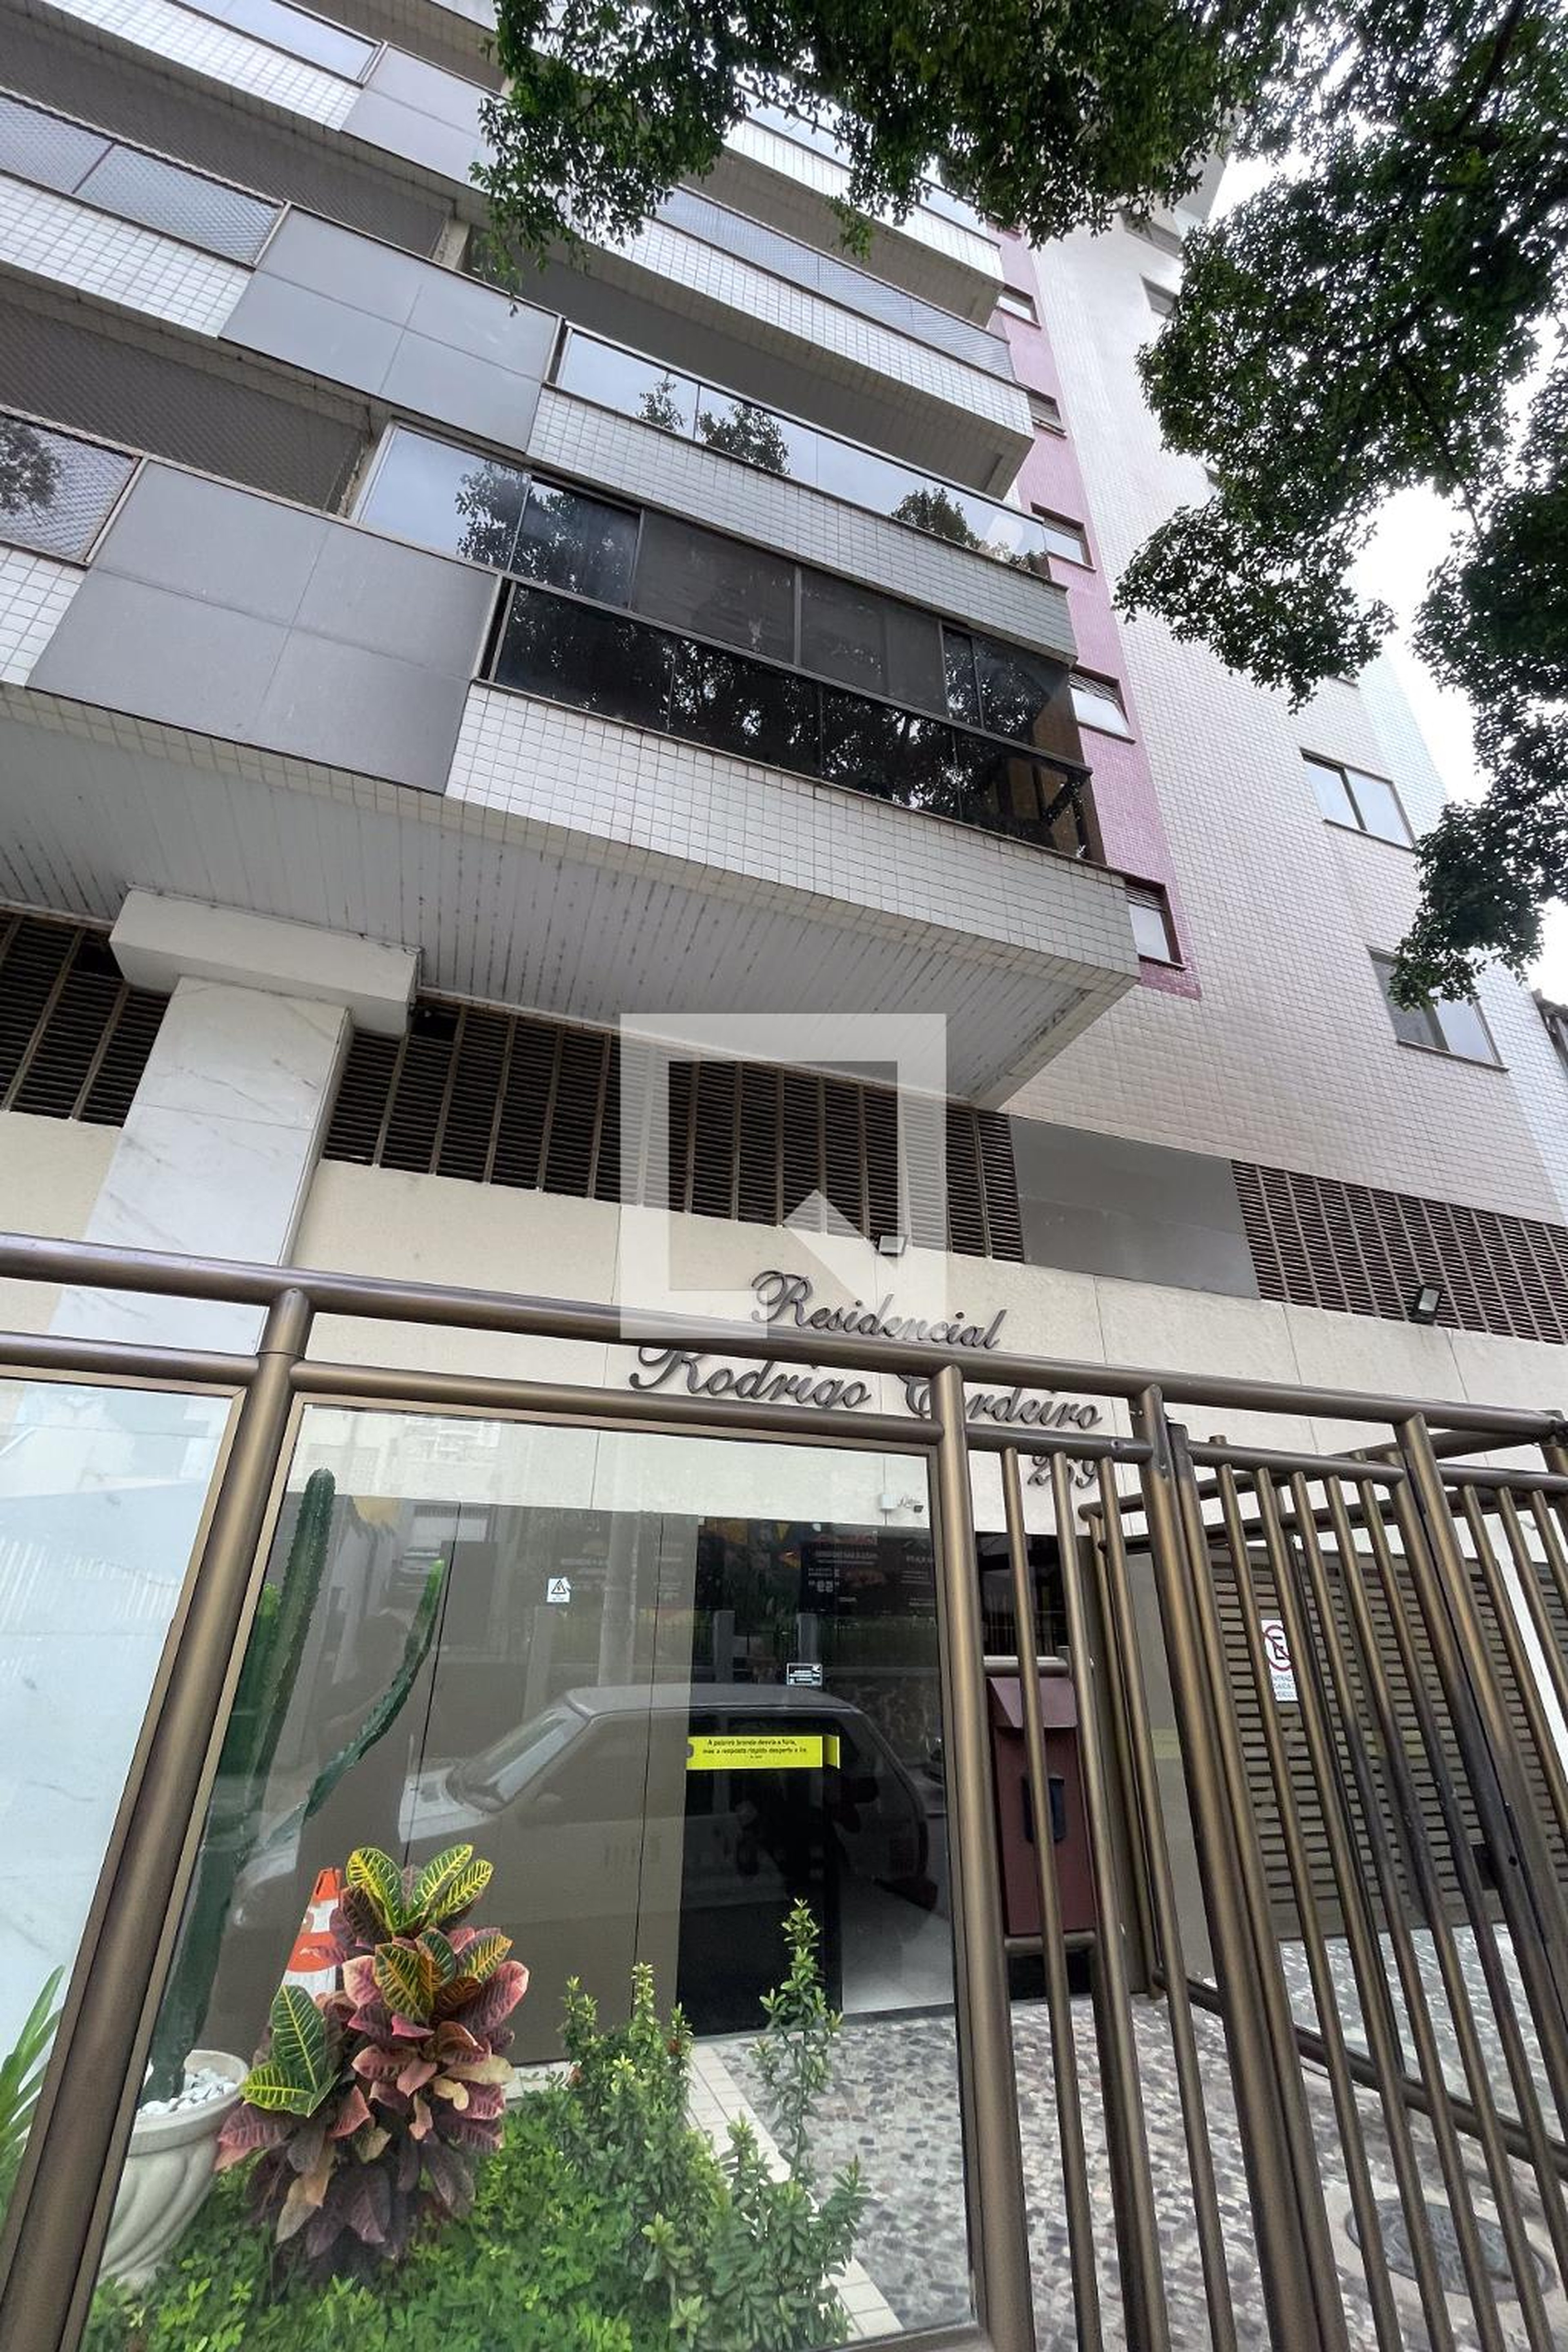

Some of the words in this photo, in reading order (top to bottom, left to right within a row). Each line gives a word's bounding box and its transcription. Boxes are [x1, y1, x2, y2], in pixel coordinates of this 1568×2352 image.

[752, 1270, 1007, 1349] Residencial
[629, 1347, 871, 1409] Rodrigo
[898, 1374, 1102, 1429] Crdeiro
